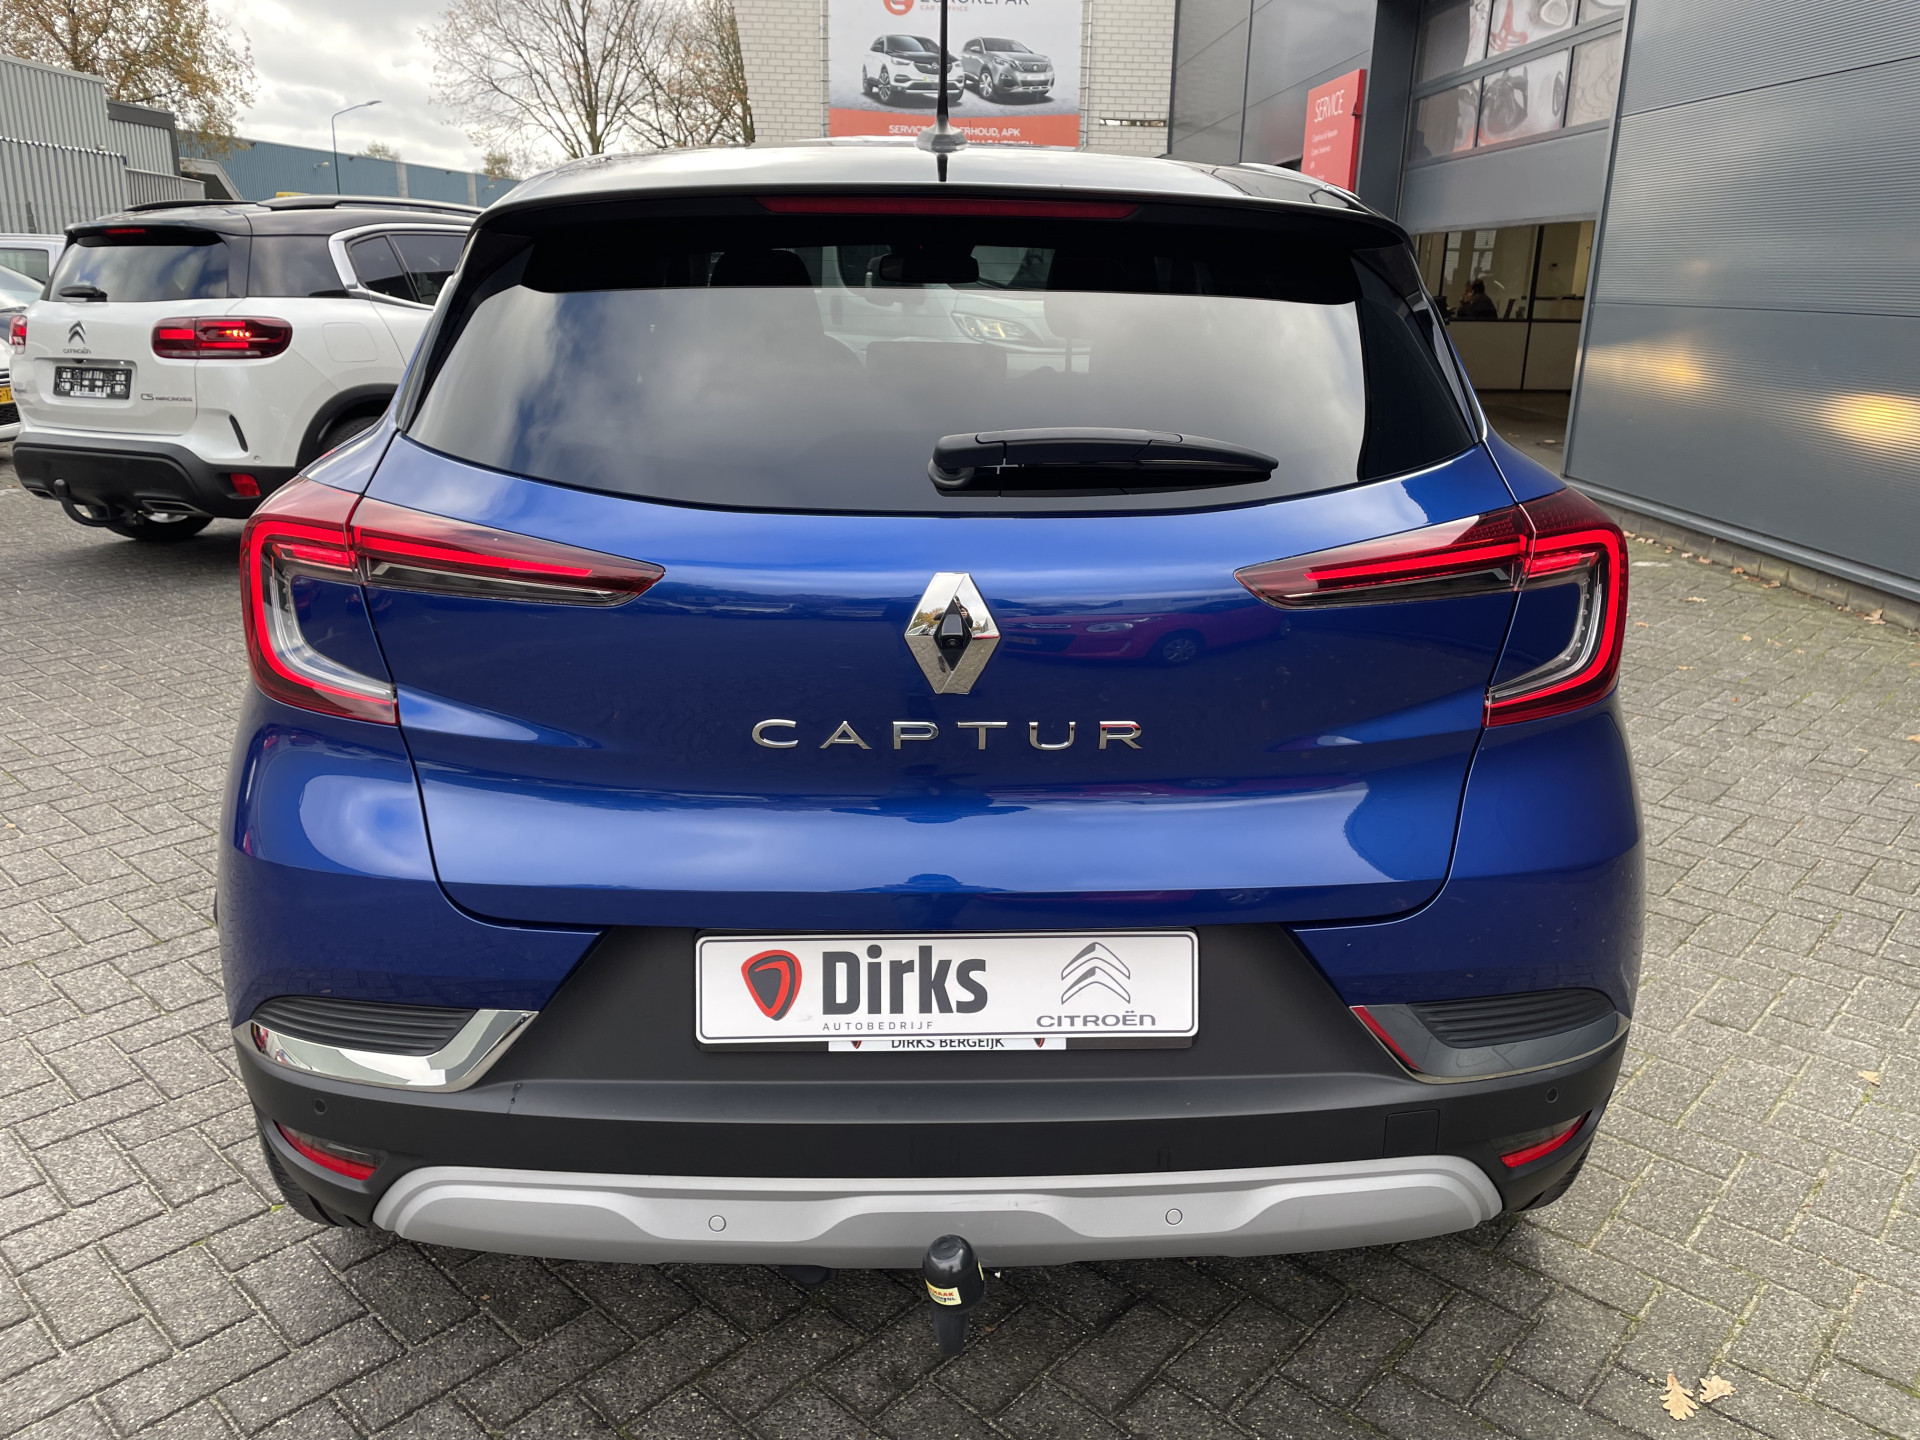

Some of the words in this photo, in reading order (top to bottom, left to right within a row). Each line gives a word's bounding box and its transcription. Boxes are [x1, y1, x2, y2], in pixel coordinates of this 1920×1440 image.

[1313, 90, 1345, 123] SERVICE
[1001, 128, 1021, 136] APK
[751, 718, 1143, 750] CAPTUR
[822, 944, 987, 1016] Dirks
[822, 1021, 934, 1031] AUTOBEDRIJF
[1036, 1010, 1157, 1028] CITROËN
[891, 1038, 936, 1049] DIRKS
